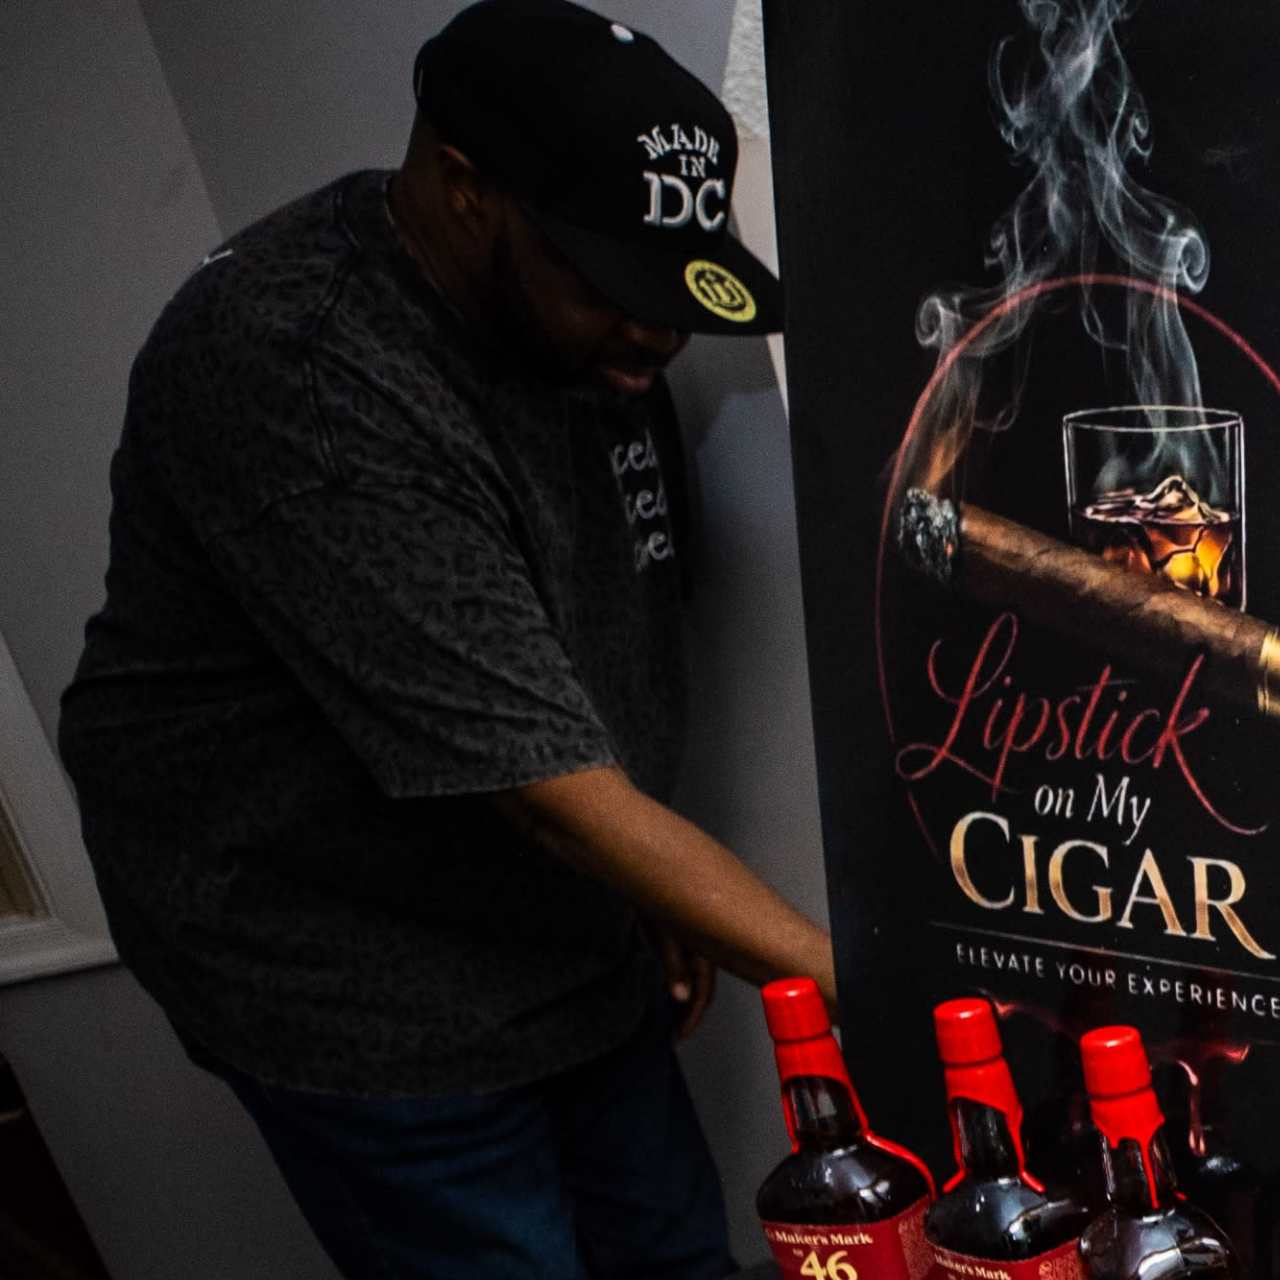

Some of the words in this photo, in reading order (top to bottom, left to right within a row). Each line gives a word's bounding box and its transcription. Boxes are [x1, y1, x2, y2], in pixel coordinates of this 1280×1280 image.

[637, 123, 720, 164] MADE
[679, 155, 706, 178] IN
[643, 171, 725, 231] DC
[895, 612, 1268, 836] Lipstick
[1034, 783, 1074, 821] on
[1087, 774, 1151, 845] My
[949, 811, 1277, 960] CIGAR
[956, 943, 1045, 979] ELEVATE
[1056, 961, 1116, 991] YOUR
[774, 1230, 829, 1245] Maker's
[830, 1232, 874, 1246] Mark
